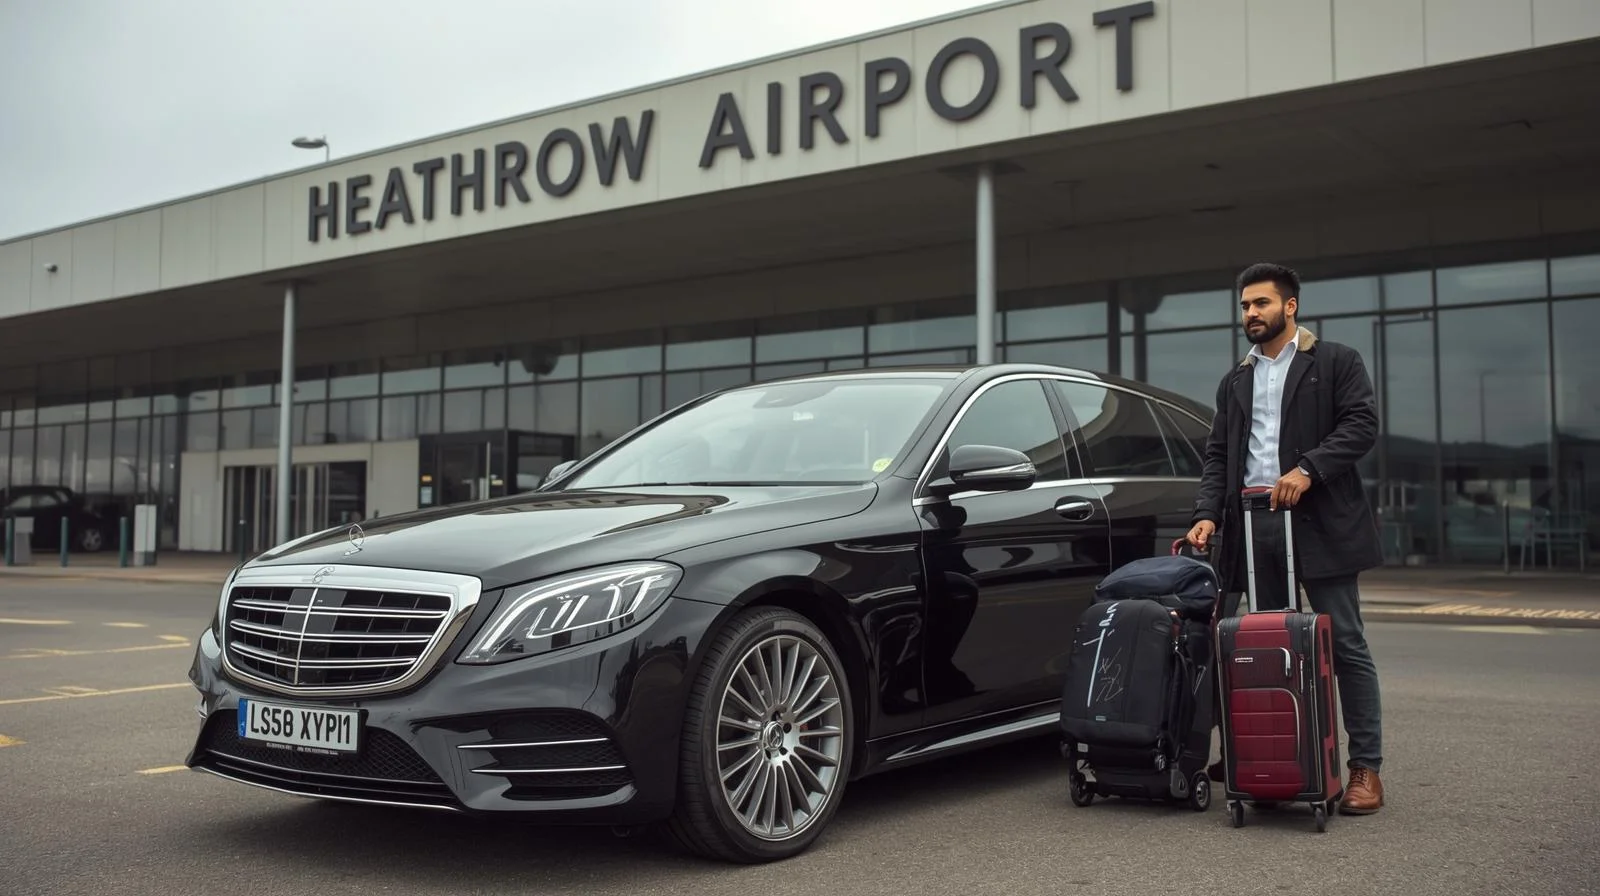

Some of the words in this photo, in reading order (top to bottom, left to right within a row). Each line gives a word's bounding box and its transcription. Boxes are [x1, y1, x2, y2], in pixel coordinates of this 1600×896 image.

[308, 109, 655, 243] HEATHROW
[699, 0, 1155, 169] AIRPORT
[250, 703, 294, 737] LS58
